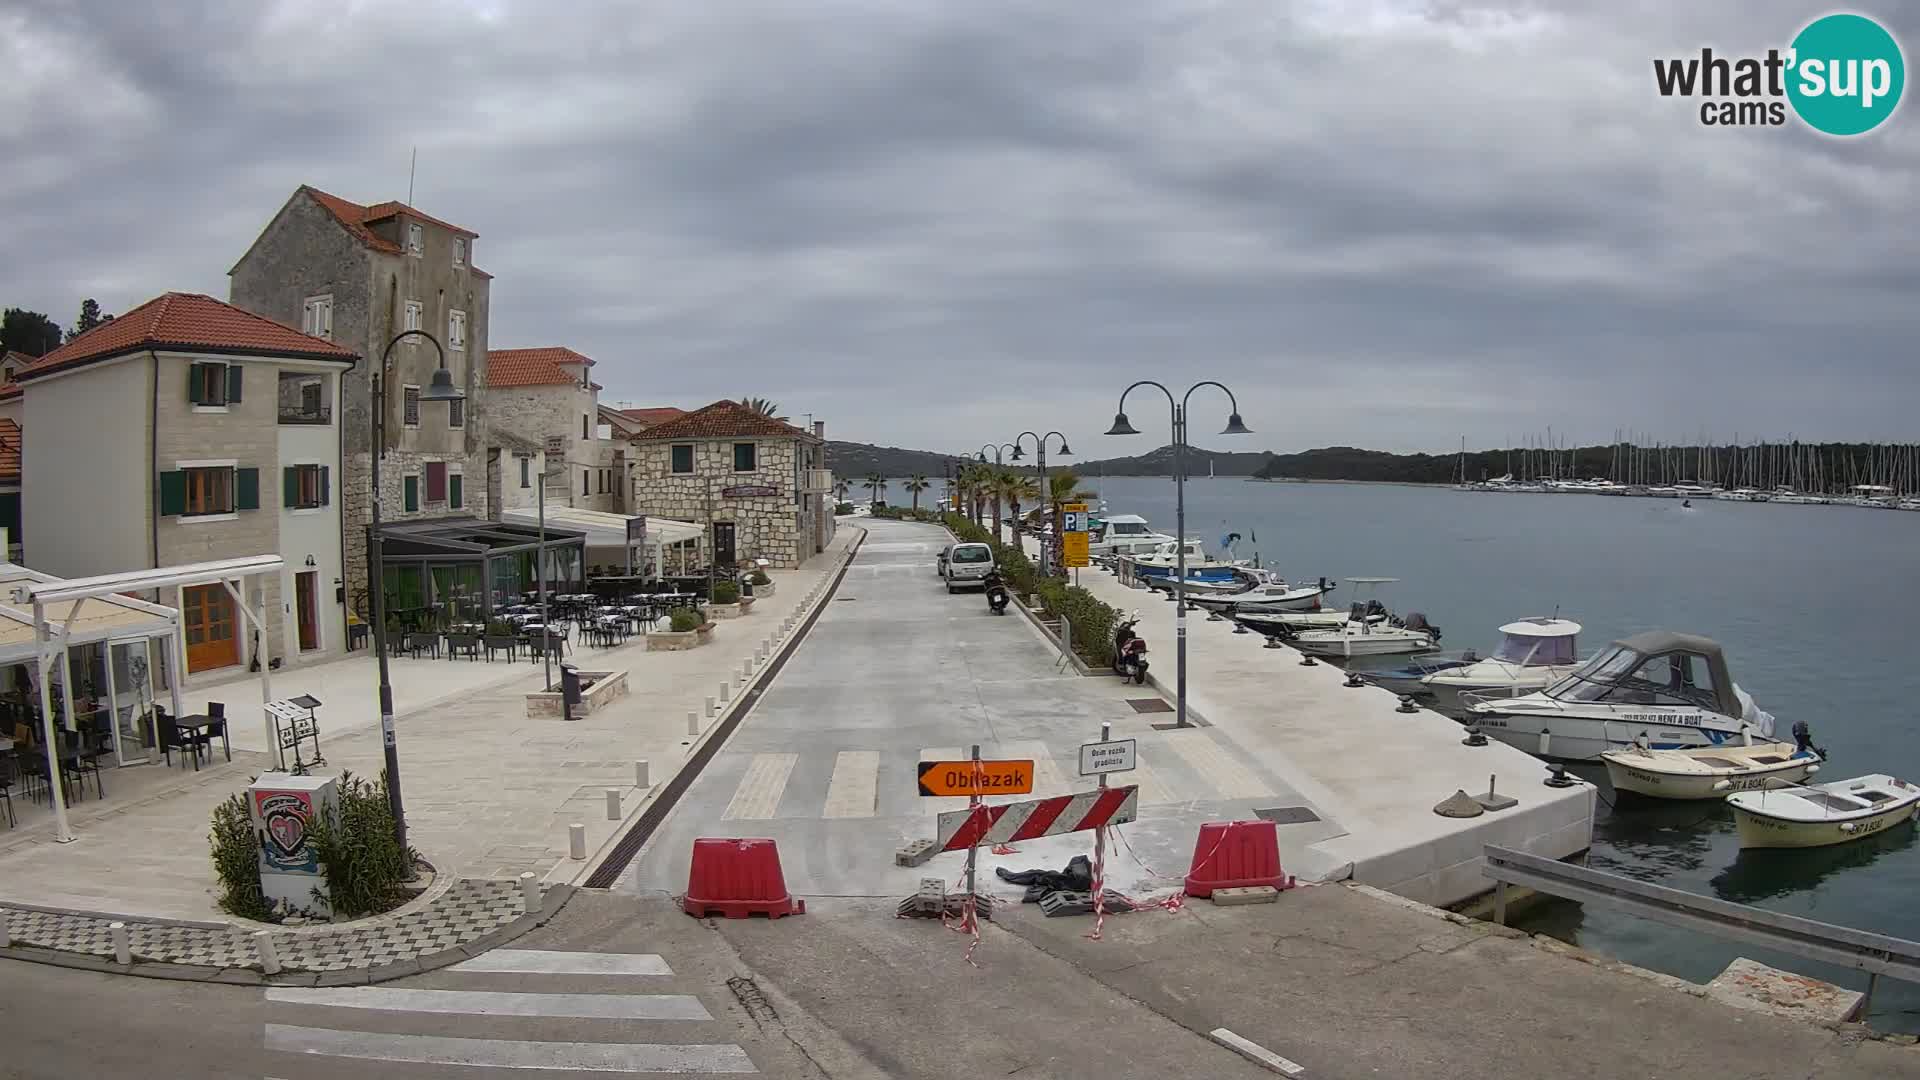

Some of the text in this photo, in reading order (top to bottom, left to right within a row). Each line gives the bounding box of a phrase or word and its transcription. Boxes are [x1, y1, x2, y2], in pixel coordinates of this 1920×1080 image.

[1065, 514, 1076, 530] P
[1658, 714, 1677, 724] RENT
[1678, 715, 1683, 725] A
[1684, 715, 1703, 726] BOAT
[946, 768, 1025, 788] Obilazak
